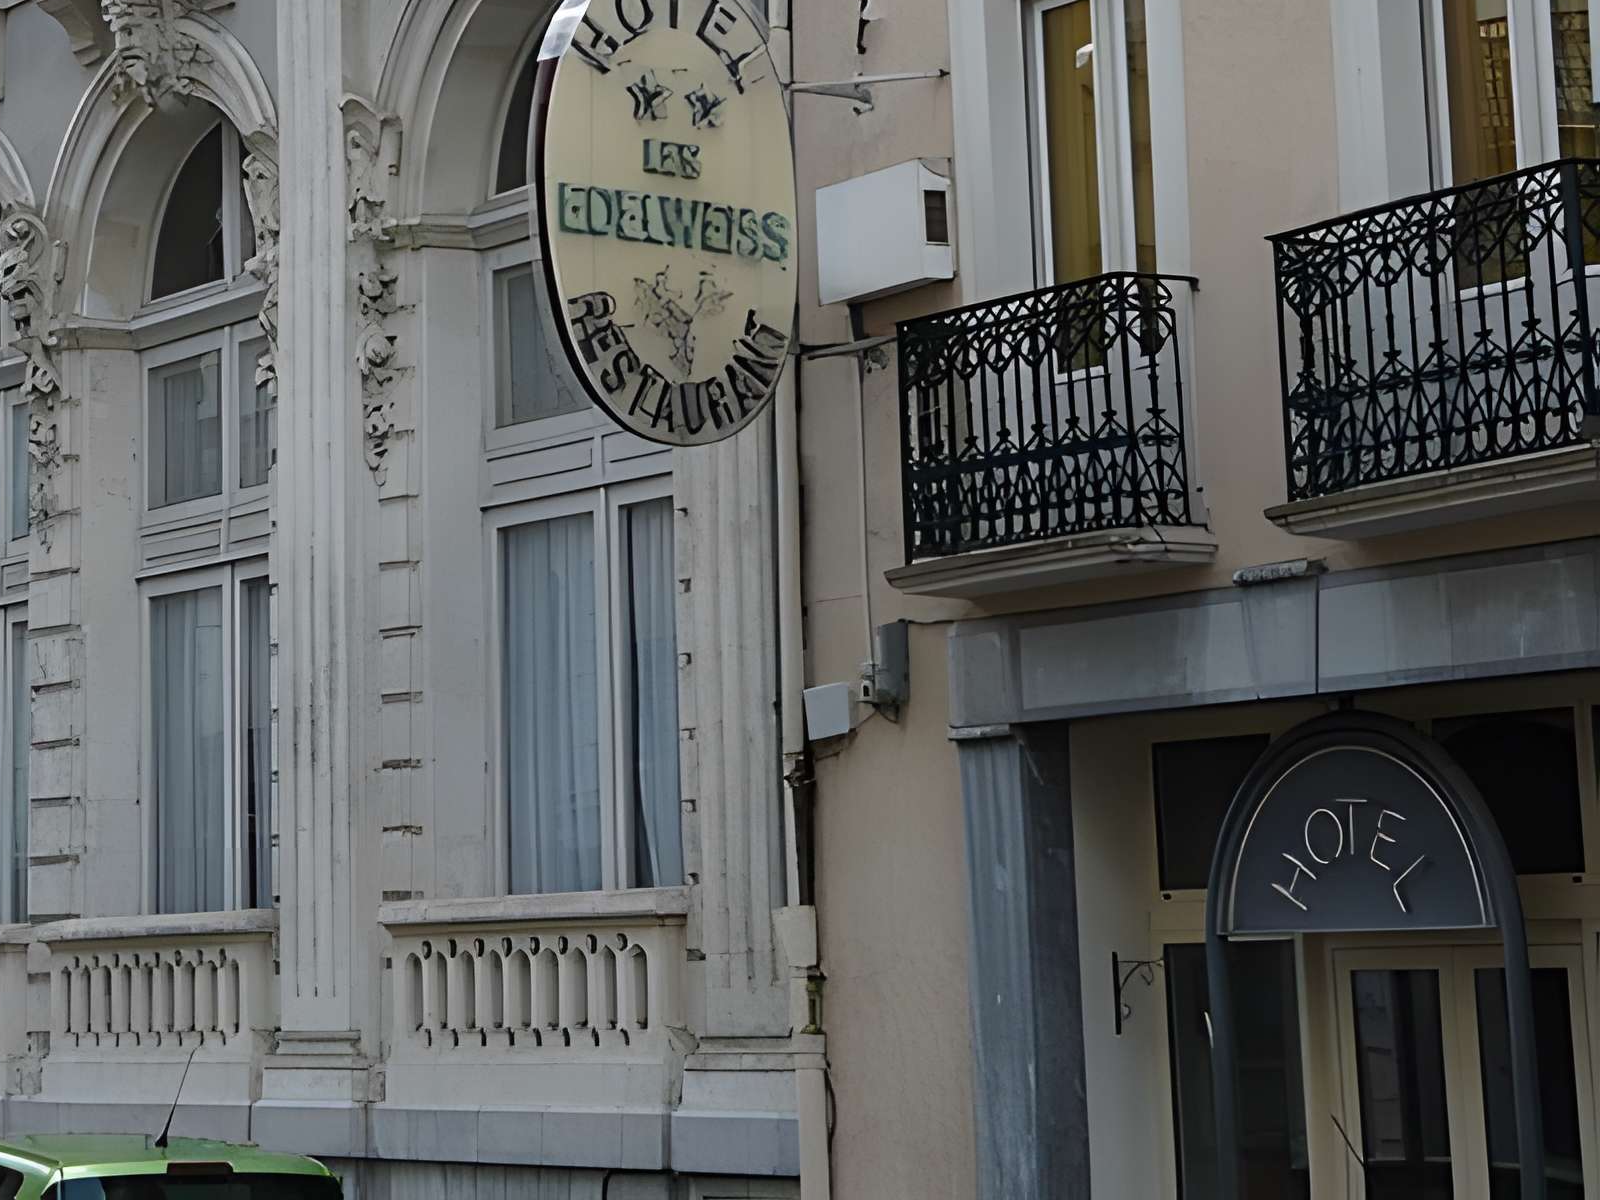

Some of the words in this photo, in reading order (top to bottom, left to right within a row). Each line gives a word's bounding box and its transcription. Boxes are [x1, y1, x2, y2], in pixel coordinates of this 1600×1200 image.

[643, 138, 700, 180] LES
[567, 291, 789, 435] RESTAURANT
[1271, 798, 1425, 913] HOTEL
